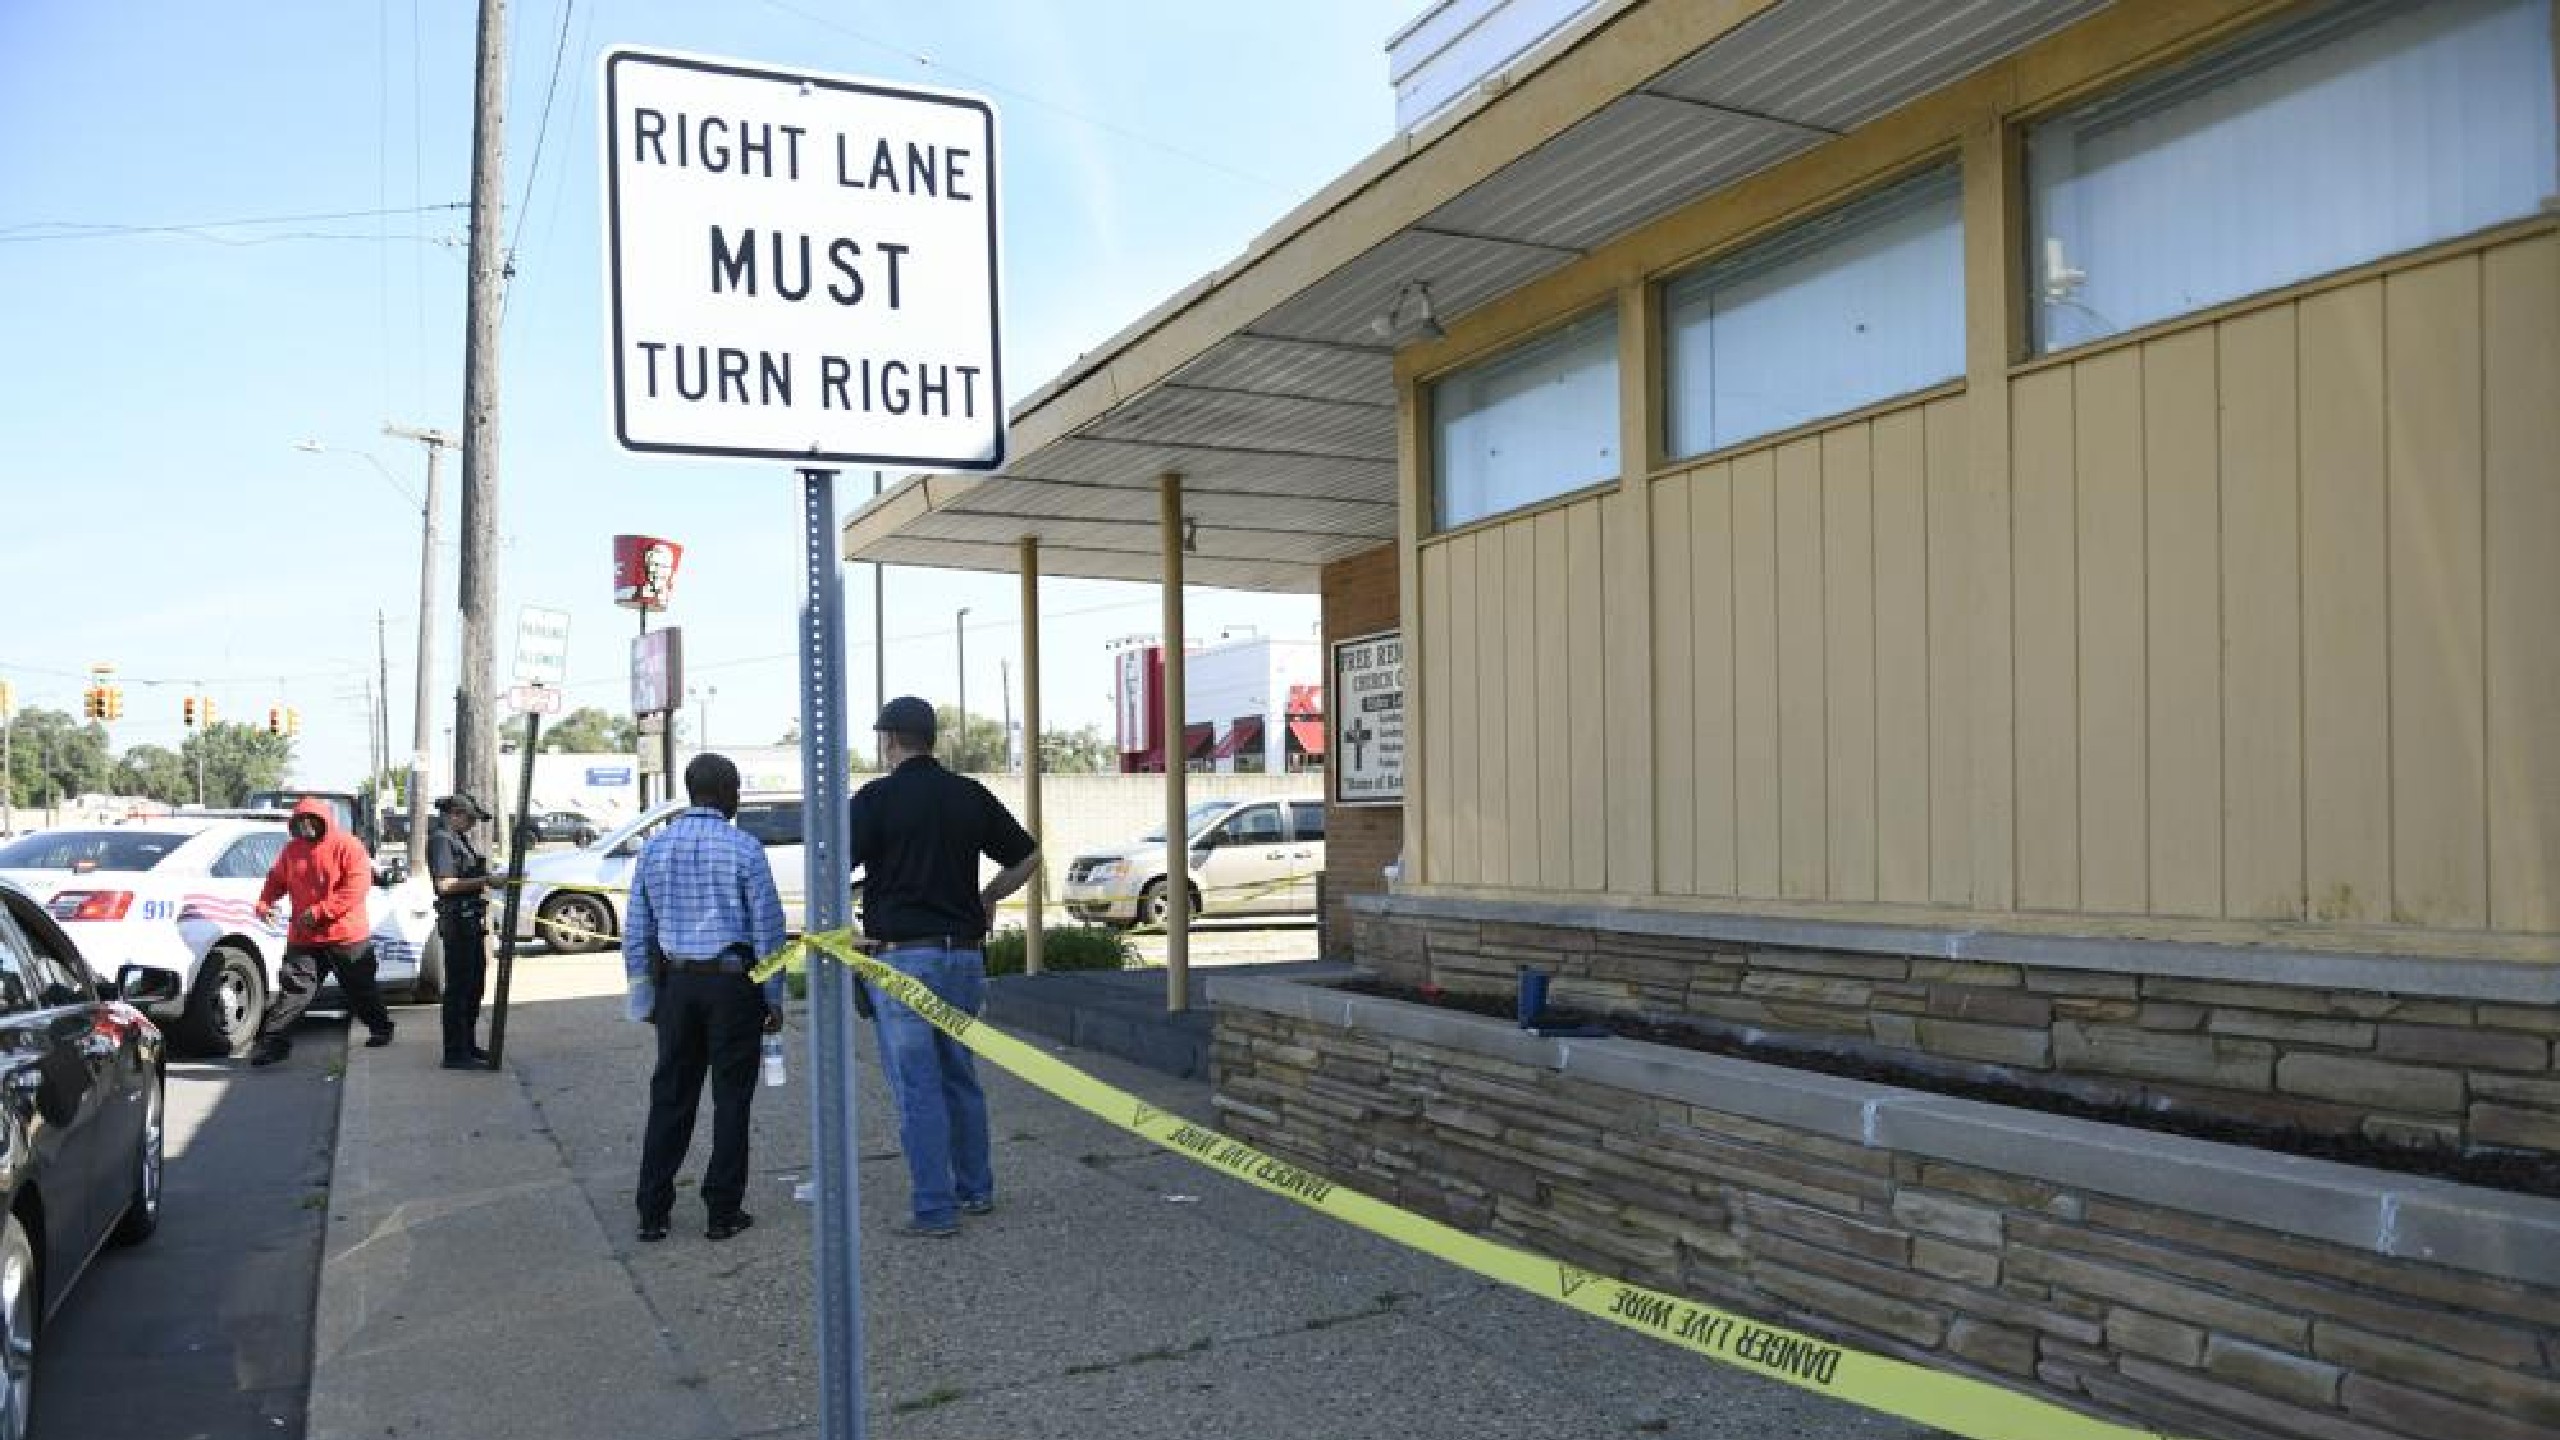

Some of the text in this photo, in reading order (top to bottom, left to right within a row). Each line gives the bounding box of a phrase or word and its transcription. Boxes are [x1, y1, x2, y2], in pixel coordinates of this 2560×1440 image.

[634, 107, 973, 202] RIGHT LANE
[710, 224, 910, 311] MUST
[636, 341, 982, 419] TURN RIGHT
[143, 900, 174, 920] 911
[1256, 1159, 1332, 1203] DANGER
[1607, 1288, 1842, 1386] DANGER LIVE WIRE
